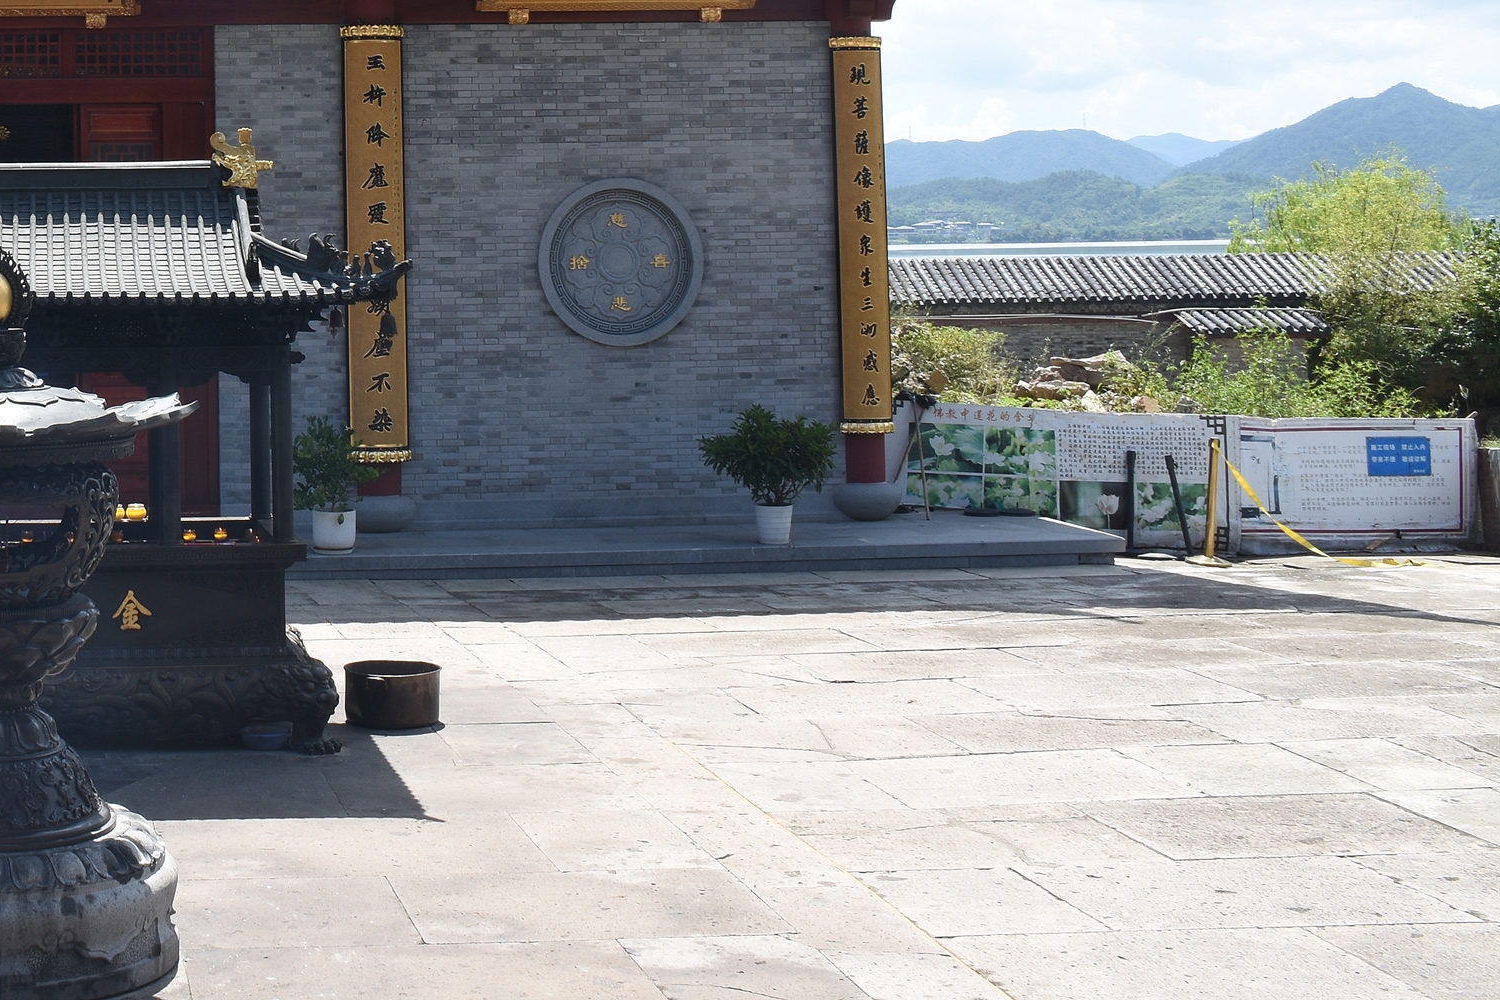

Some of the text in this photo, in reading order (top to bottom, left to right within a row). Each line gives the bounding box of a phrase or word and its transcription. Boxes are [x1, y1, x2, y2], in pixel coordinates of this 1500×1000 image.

[650, 253, 670, 268] 喜
[611, 296, 632, 312] 悲
[112, 590, 153, 631] 金
